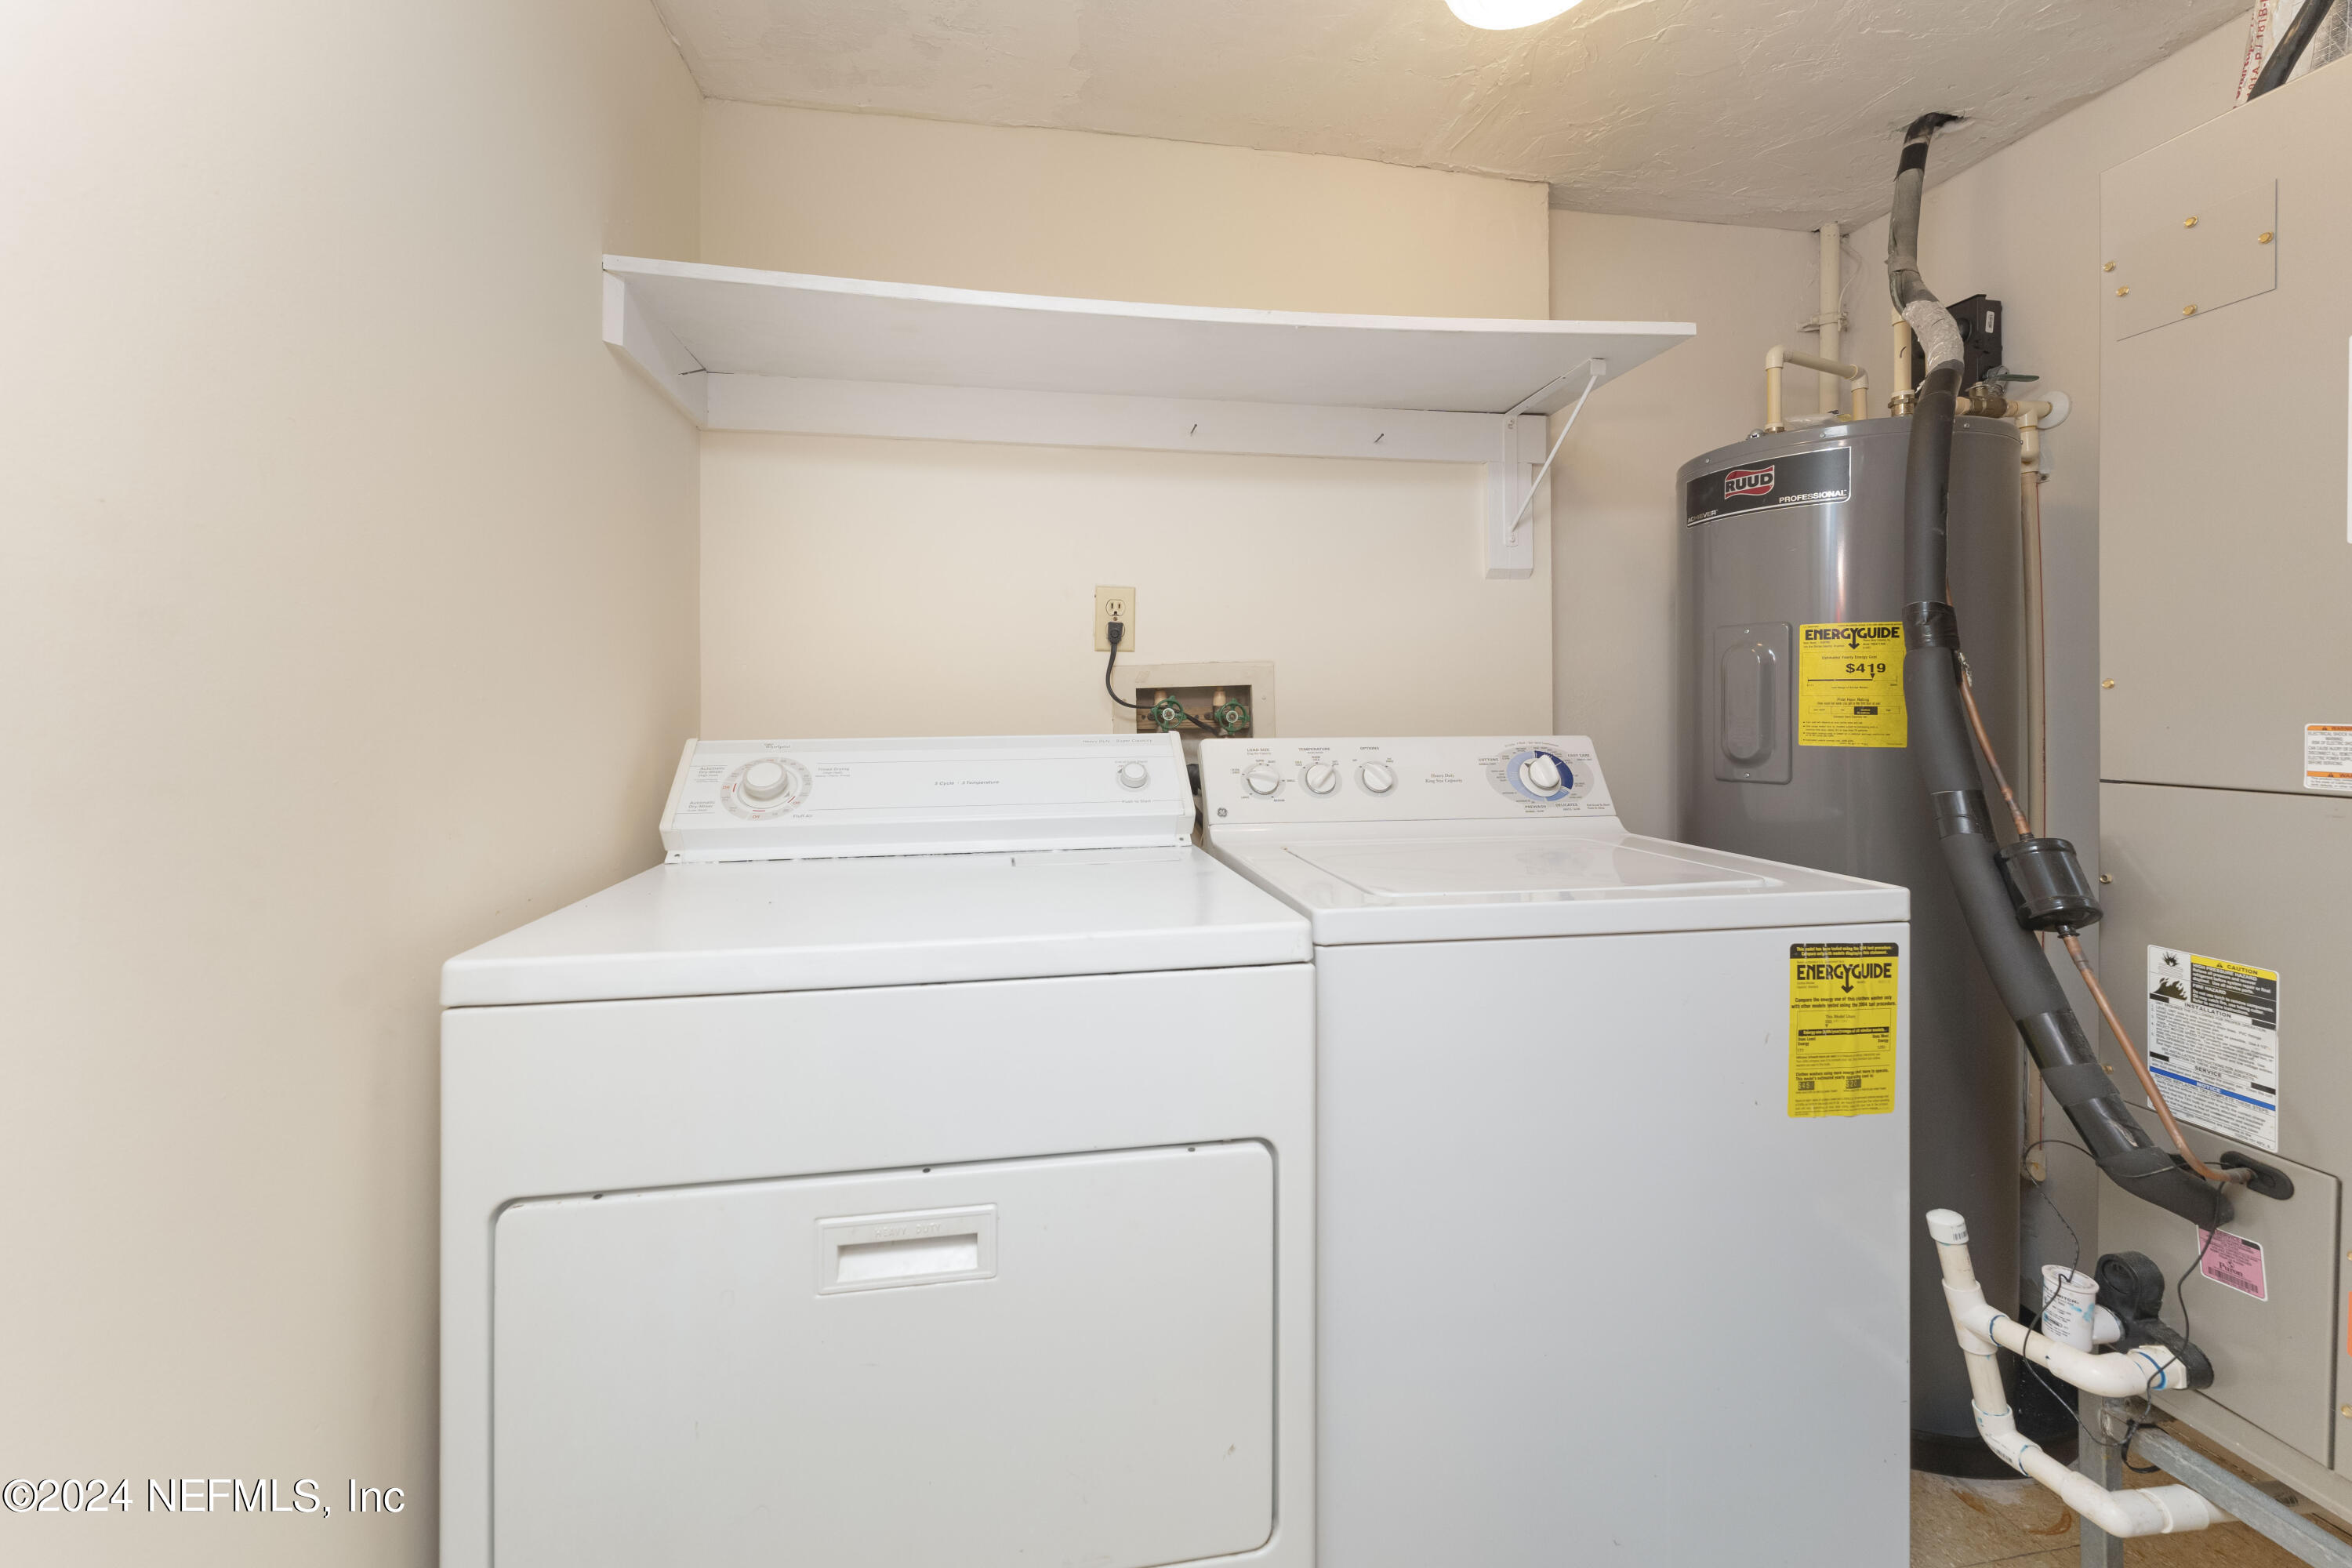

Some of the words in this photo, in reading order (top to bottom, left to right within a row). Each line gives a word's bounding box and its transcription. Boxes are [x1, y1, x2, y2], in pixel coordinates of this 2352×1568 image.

[1725, 473, 1773, 493] RUUD
[1779, 489, 1847, 503] PROFESSIONAL
[1805, 626, 1900, 641] ENERGYGUIDE
[1846, 663, 1886, 673] $419
[1797, 963, 1892, 981] ENERGYGUIDE
[2227, 964, 2258, 975] CAUTION
[2234, 972, 2257, 981] HAZARD
[2205, 986, 2227, 995] HAZARD
[2184, 1003, 2231, 1018] INSTALLATION
[2194, 1065, 2222, 1078] SERVICE
[2196, 1081, 2221, 1093] NOTICE
[916, 1224, 942, 1234] DUTY
[2219, 1261, 2243, 1277] Puron
